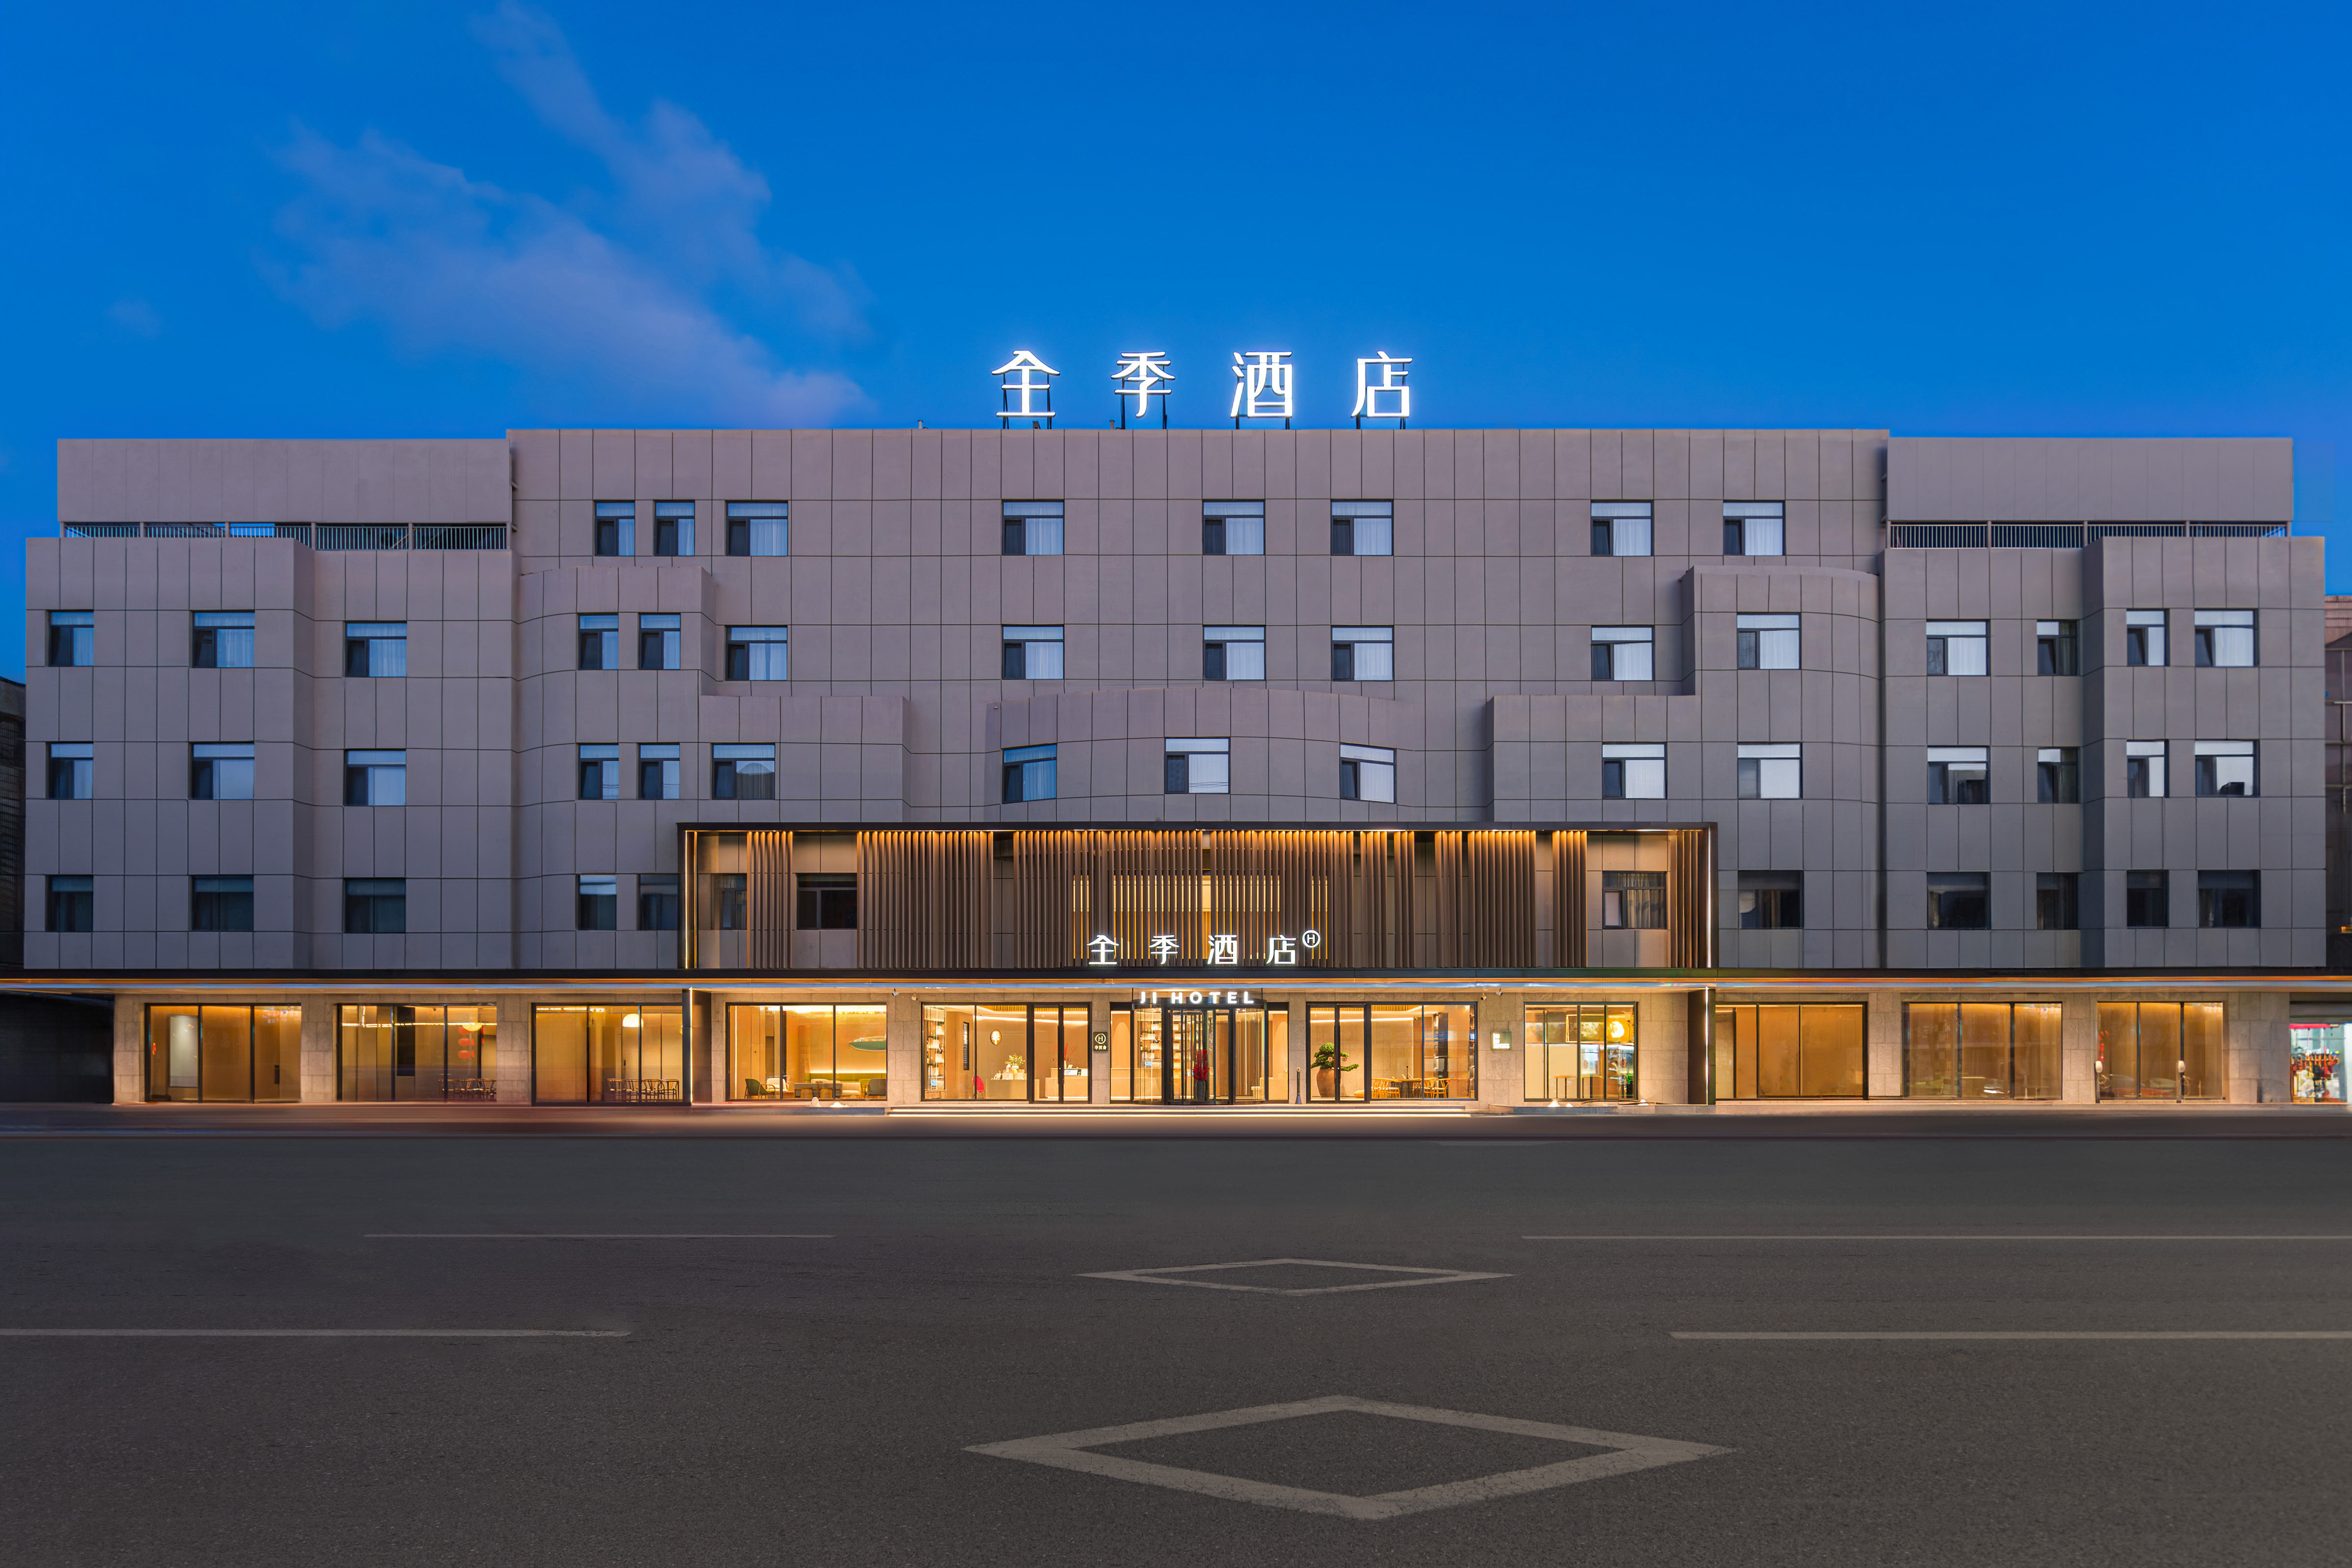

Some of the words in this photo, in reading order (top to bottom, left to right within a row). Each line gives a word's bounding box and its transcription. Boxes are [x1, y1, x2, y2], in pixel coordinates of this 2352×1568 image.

[991, 350, 1413, 417] 全季酒店
[1086, 934, 1297, 965] 全季酒店
[1140, 991, 1157, 1004] JI
[1171, 991, 1254, 1004] HOTEL
